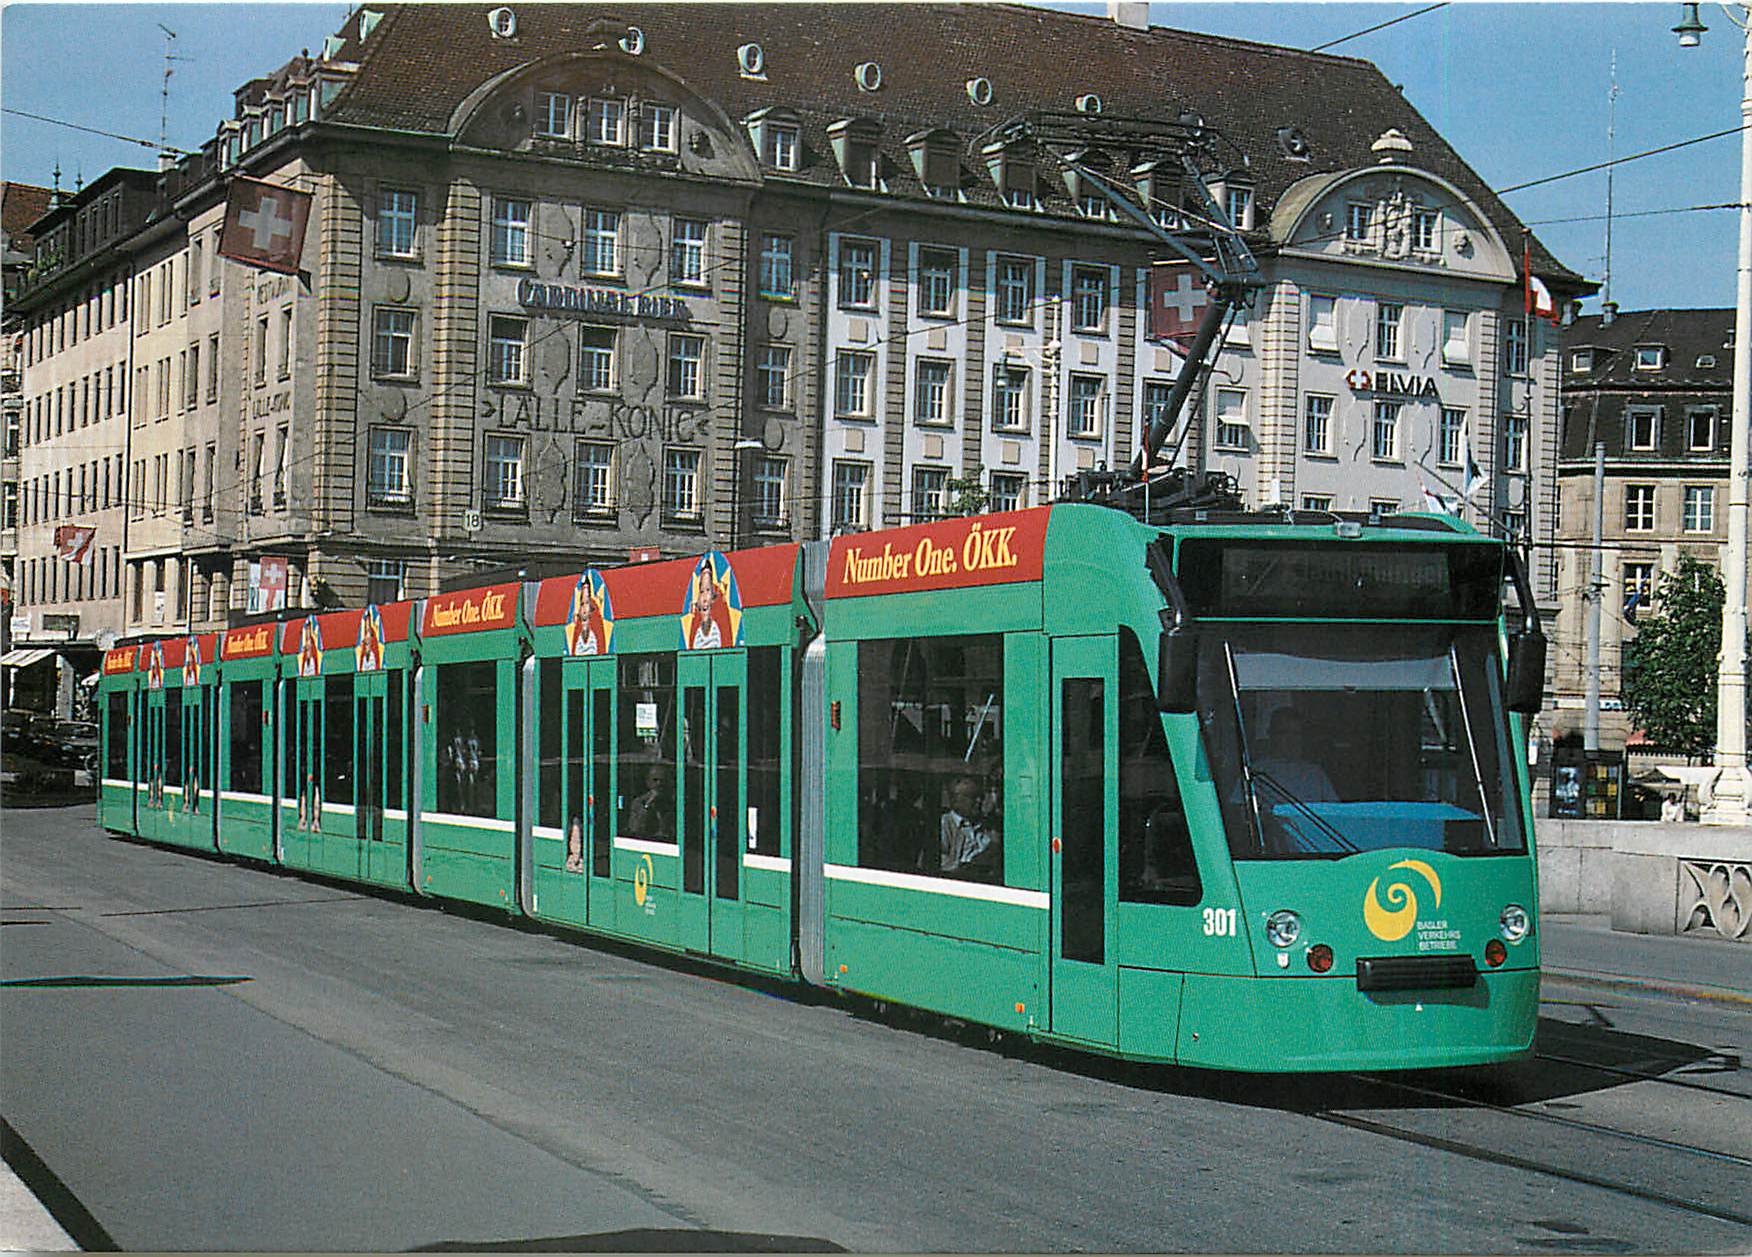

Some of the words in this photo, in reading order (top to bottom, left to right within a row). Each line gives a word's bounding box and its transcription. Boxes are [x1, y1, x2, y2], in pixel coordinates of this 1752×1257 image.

[467, 514, 479, 527] 18
[842, 543, 912, 584] Number
[915, 537, 957, 577] One.
[963, 522, 1017, 571] ÖKK.
[431, 601, 461, 627] Number
[1203, 907, 1236, 937] 301
[1417, 920, 1447, 929] BASLER
